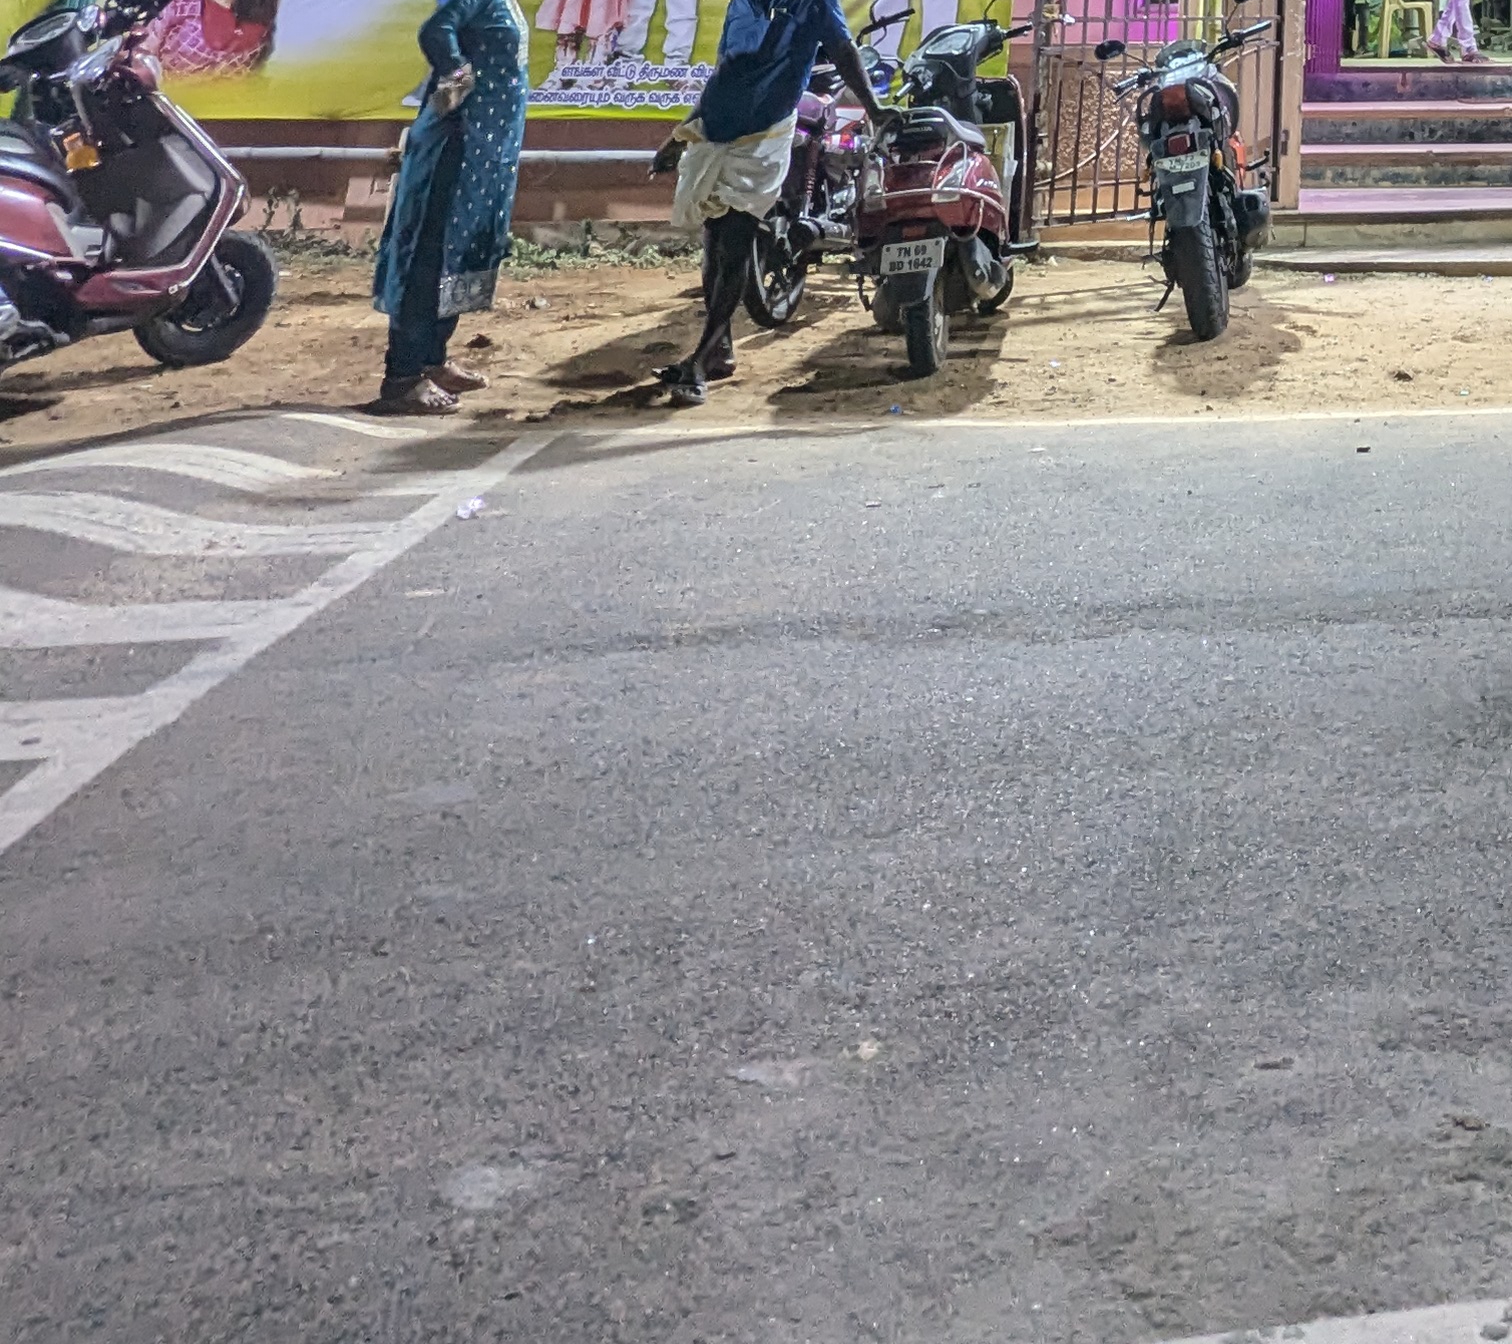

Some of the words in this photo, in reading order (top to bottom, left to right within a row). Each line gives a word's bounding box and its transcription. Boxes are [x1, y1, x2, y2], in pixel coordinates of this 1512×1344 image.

[606, 61, 637, 80] வீட்டு
[638, 62, 688, 83] திருமண
[528, 87, 611, 107] னைவரையும்
[613, 92, 645, 108] வருக
[649, 92, 681, 109] வருக
[897, 246, 911, 257] TN
